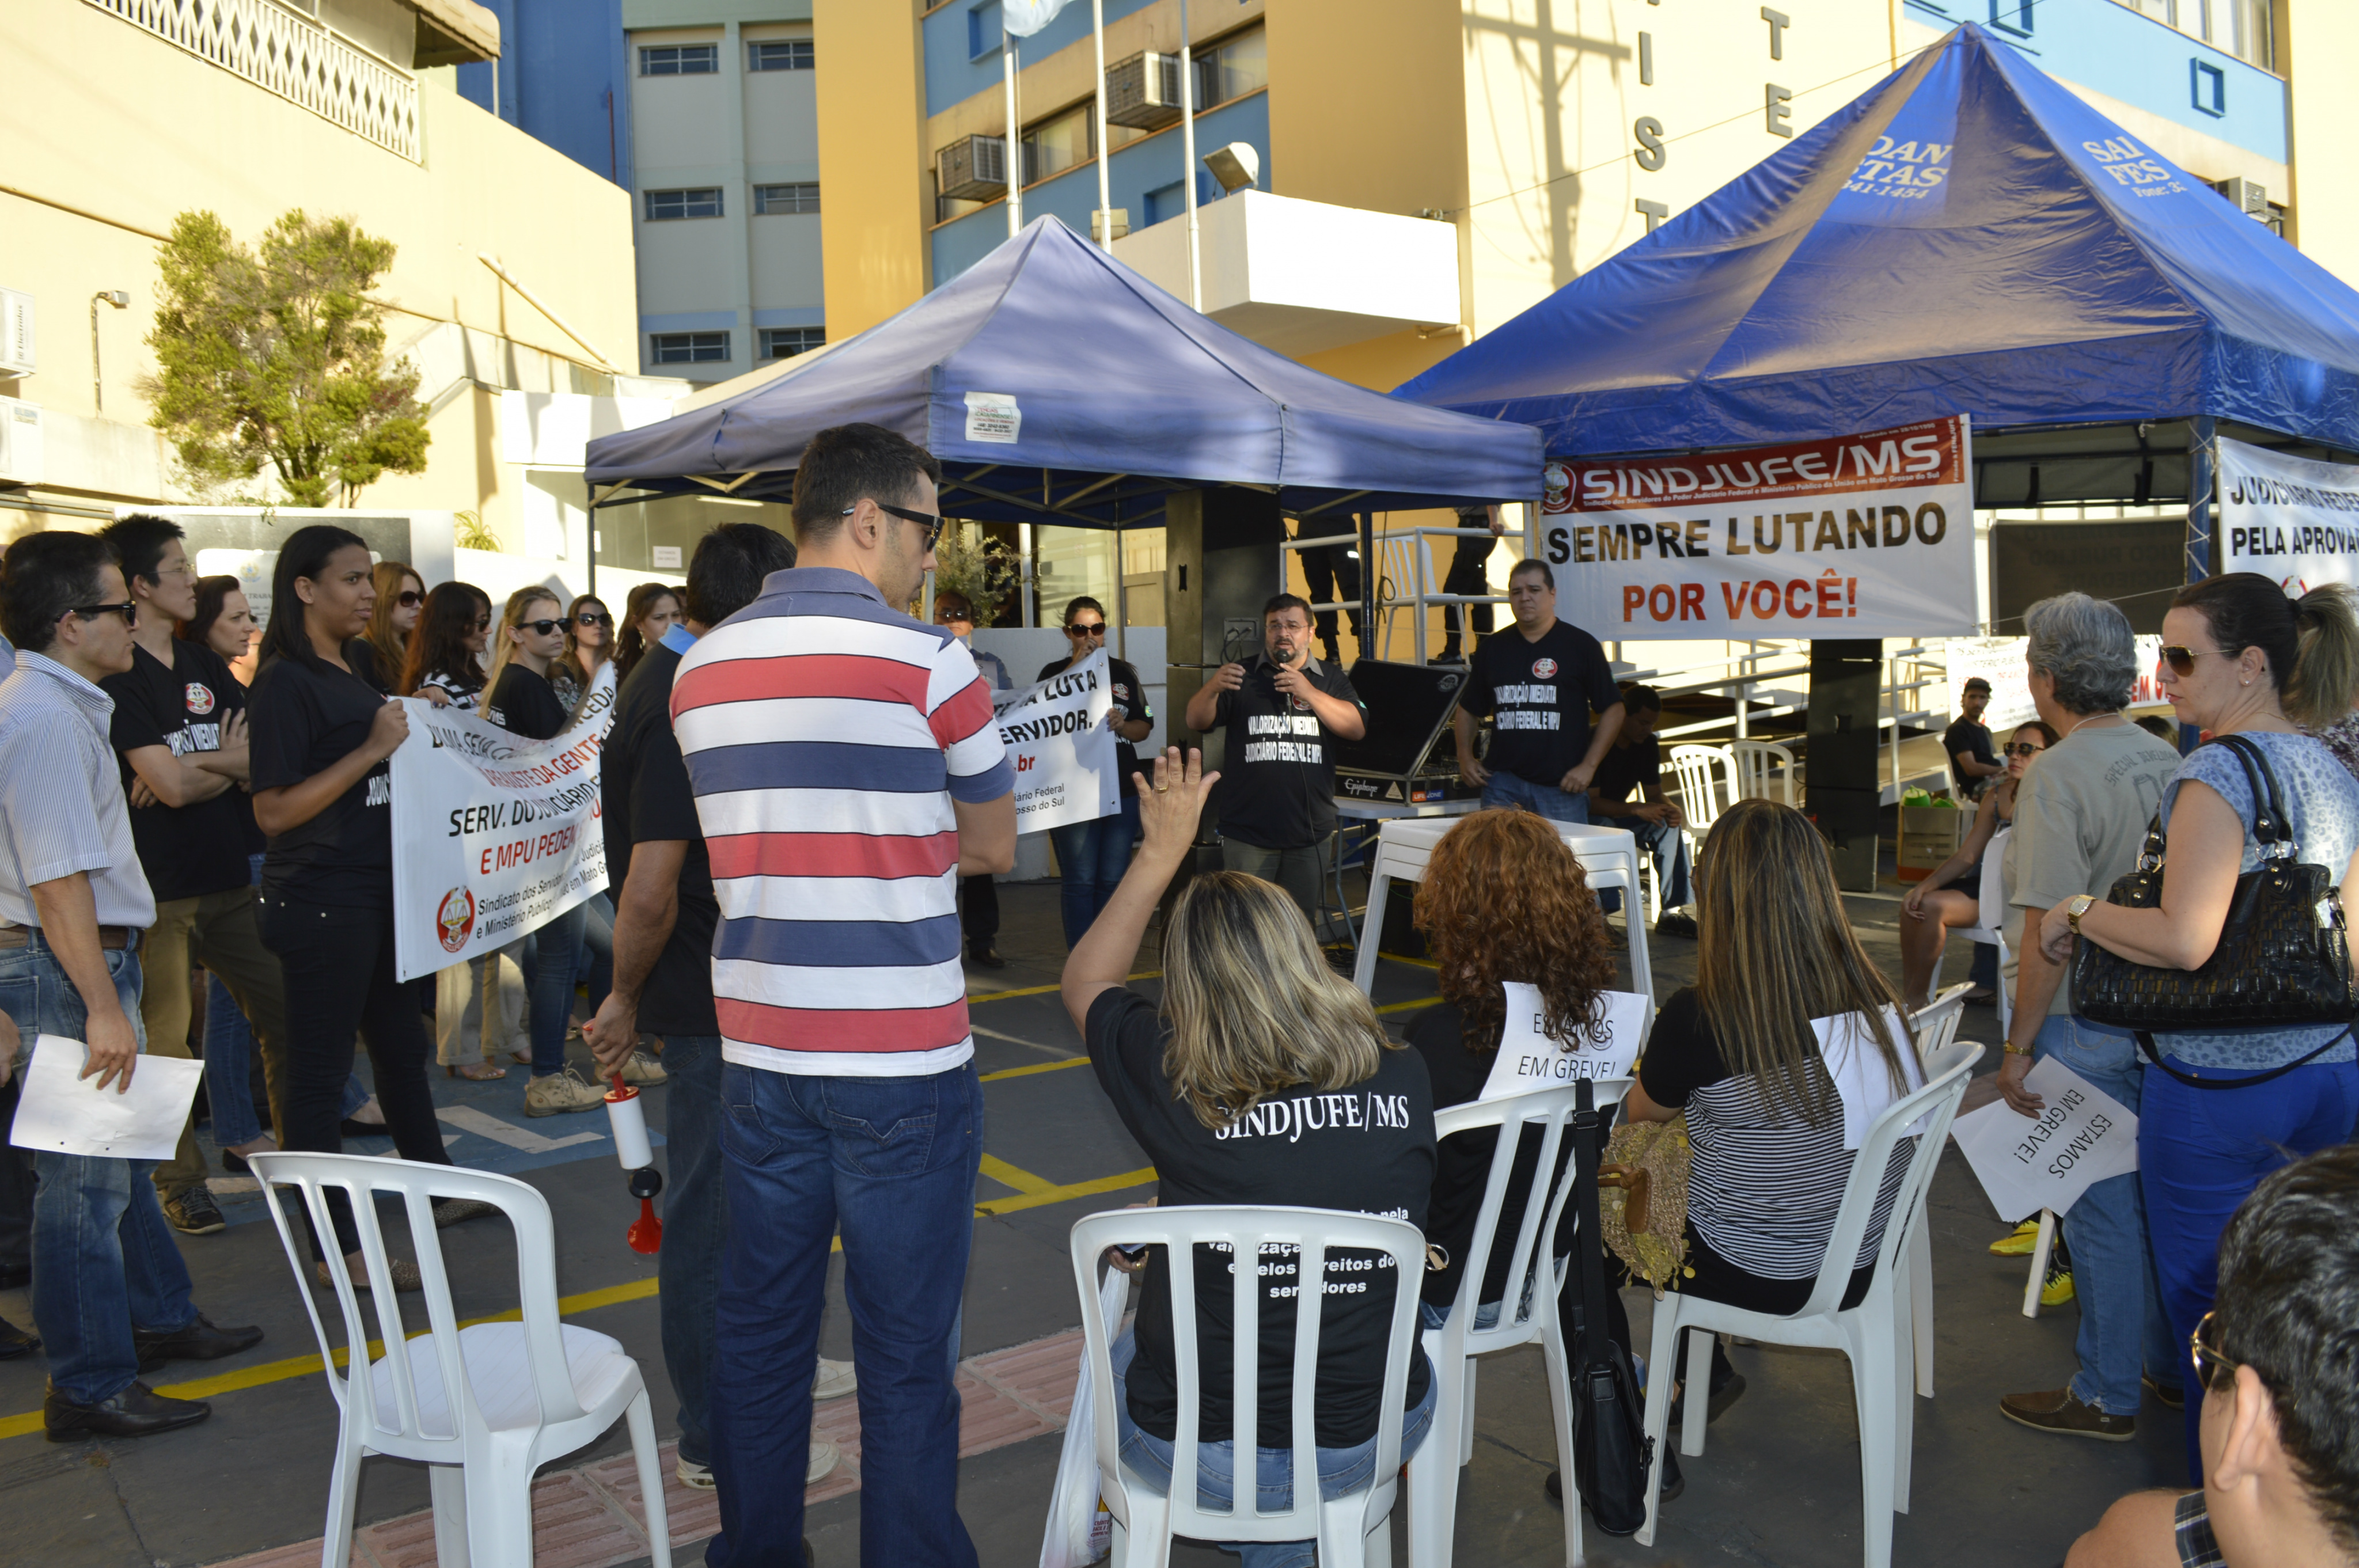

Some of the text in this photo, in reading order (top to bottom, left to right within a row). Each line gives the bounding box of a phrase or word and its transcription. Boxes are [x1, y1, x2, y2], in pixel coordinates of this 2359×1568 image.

[1853, 157, 1949, 187] TAS
[2131, 187, 2170, 198] Fone:
[1583, 434, 1941, 499] SINDJUFE/MS
[1626, 496, 1662, 504] Servidores
[1693, 490, 1727, 499] Judiciário
[1728, 488, 1754, 496] Federal
[1888, 474, 1914, 483] Grosso
[1548, 502, 1947, 564] SEMPRE LUTANDO
[2231, 526, 2359, 556] PELA APROVA
[1622, 568, 1857, 622] POR VOCÊ!
[1045, 670, 1098, 701] LUTA
[1247, 711, 1291, 739] VALORIZAÇÃO
[1010, 754, 1036, 772] .br
[1245, 737, 1278, 763] JUDICIÁRIO
[1307, 743, 1311, 763] E
[530, 765, 562, 785] DA
[1344, 778, 1379, 797] Epiphone
[1035, 783, 1065, 798] Federal
[1039, 800, 1050, 811] do
[1052, 796, 1065, 808] Sul
[449, 803, 506, 837] SERV.
[511, 797, 535, 826] DO
[480, 848, 492, 875] E
[496, 837, 536, 872] MPU
[476, 927, 483, 939] e
[485, 909, 526, 937] Ministério
[526, 897, 553, 921] Público
[570, 877, 581, 890] em
[579, 867, 598, 885] Mato
[478, 890, 521, 916] Sindicato
[522, 885, 536, 900] dos
[1518, 1056, 1549, 1077] EM
[2013, 1089, 2085, 1164] EM GREVE!
[2048, 1114, 2113, 1179] ESTAMOS
[1258, 1261, 1296, 1277] elos
[1323, 1258, 1373, 1272] reitos
[1269, 1281, 1367, 1299] serdores
